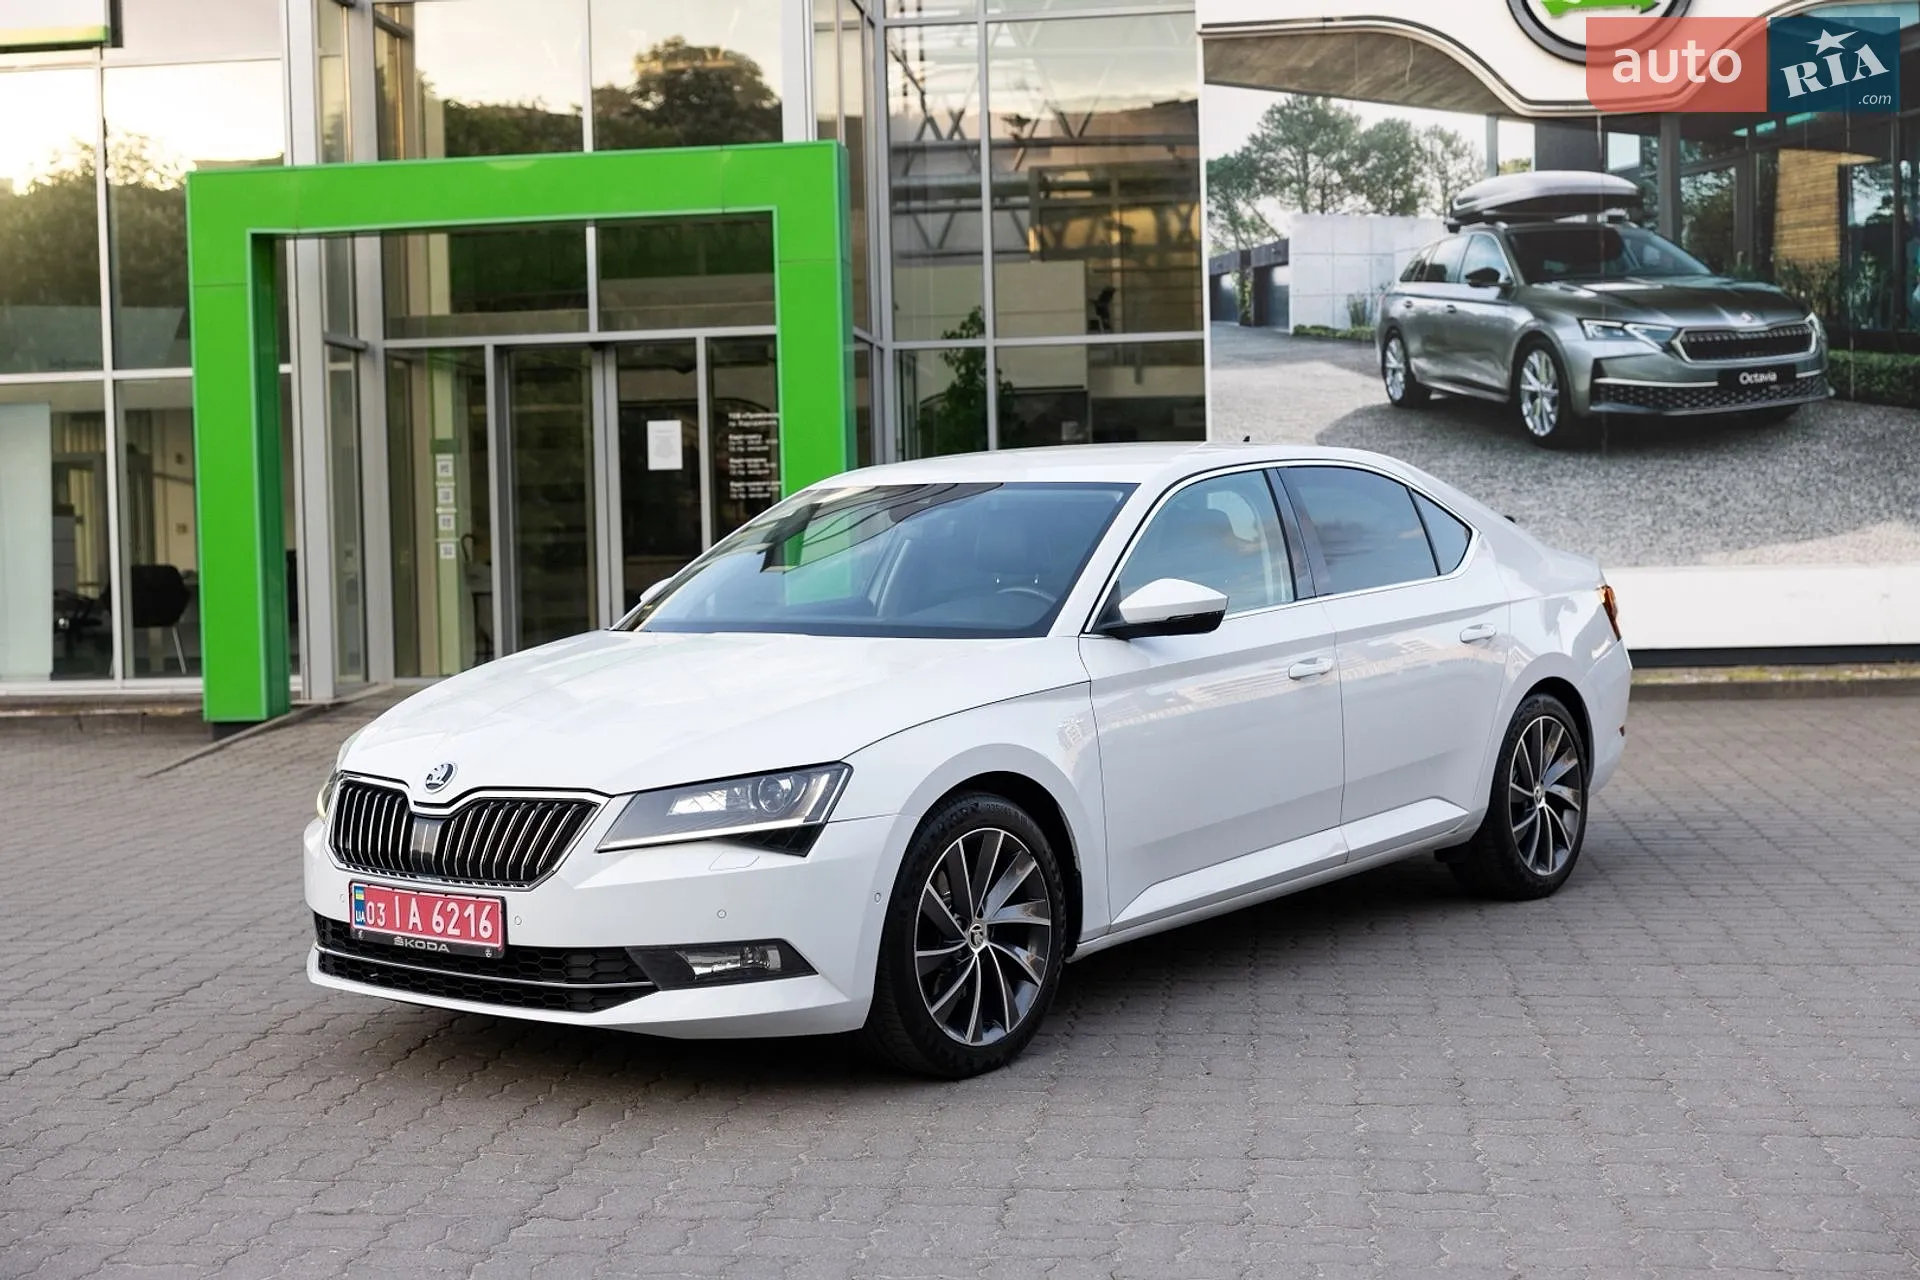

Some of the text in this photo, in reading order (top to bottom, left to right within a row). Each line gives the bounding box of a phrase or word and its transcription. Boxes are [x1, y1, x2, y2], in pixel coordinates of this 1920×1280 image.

[1738, 371, 1778, 385] Octavia
[355, 895, 493, 939] UA 03 IA 6216
[393, 936, 450, 953] ŠKODA
